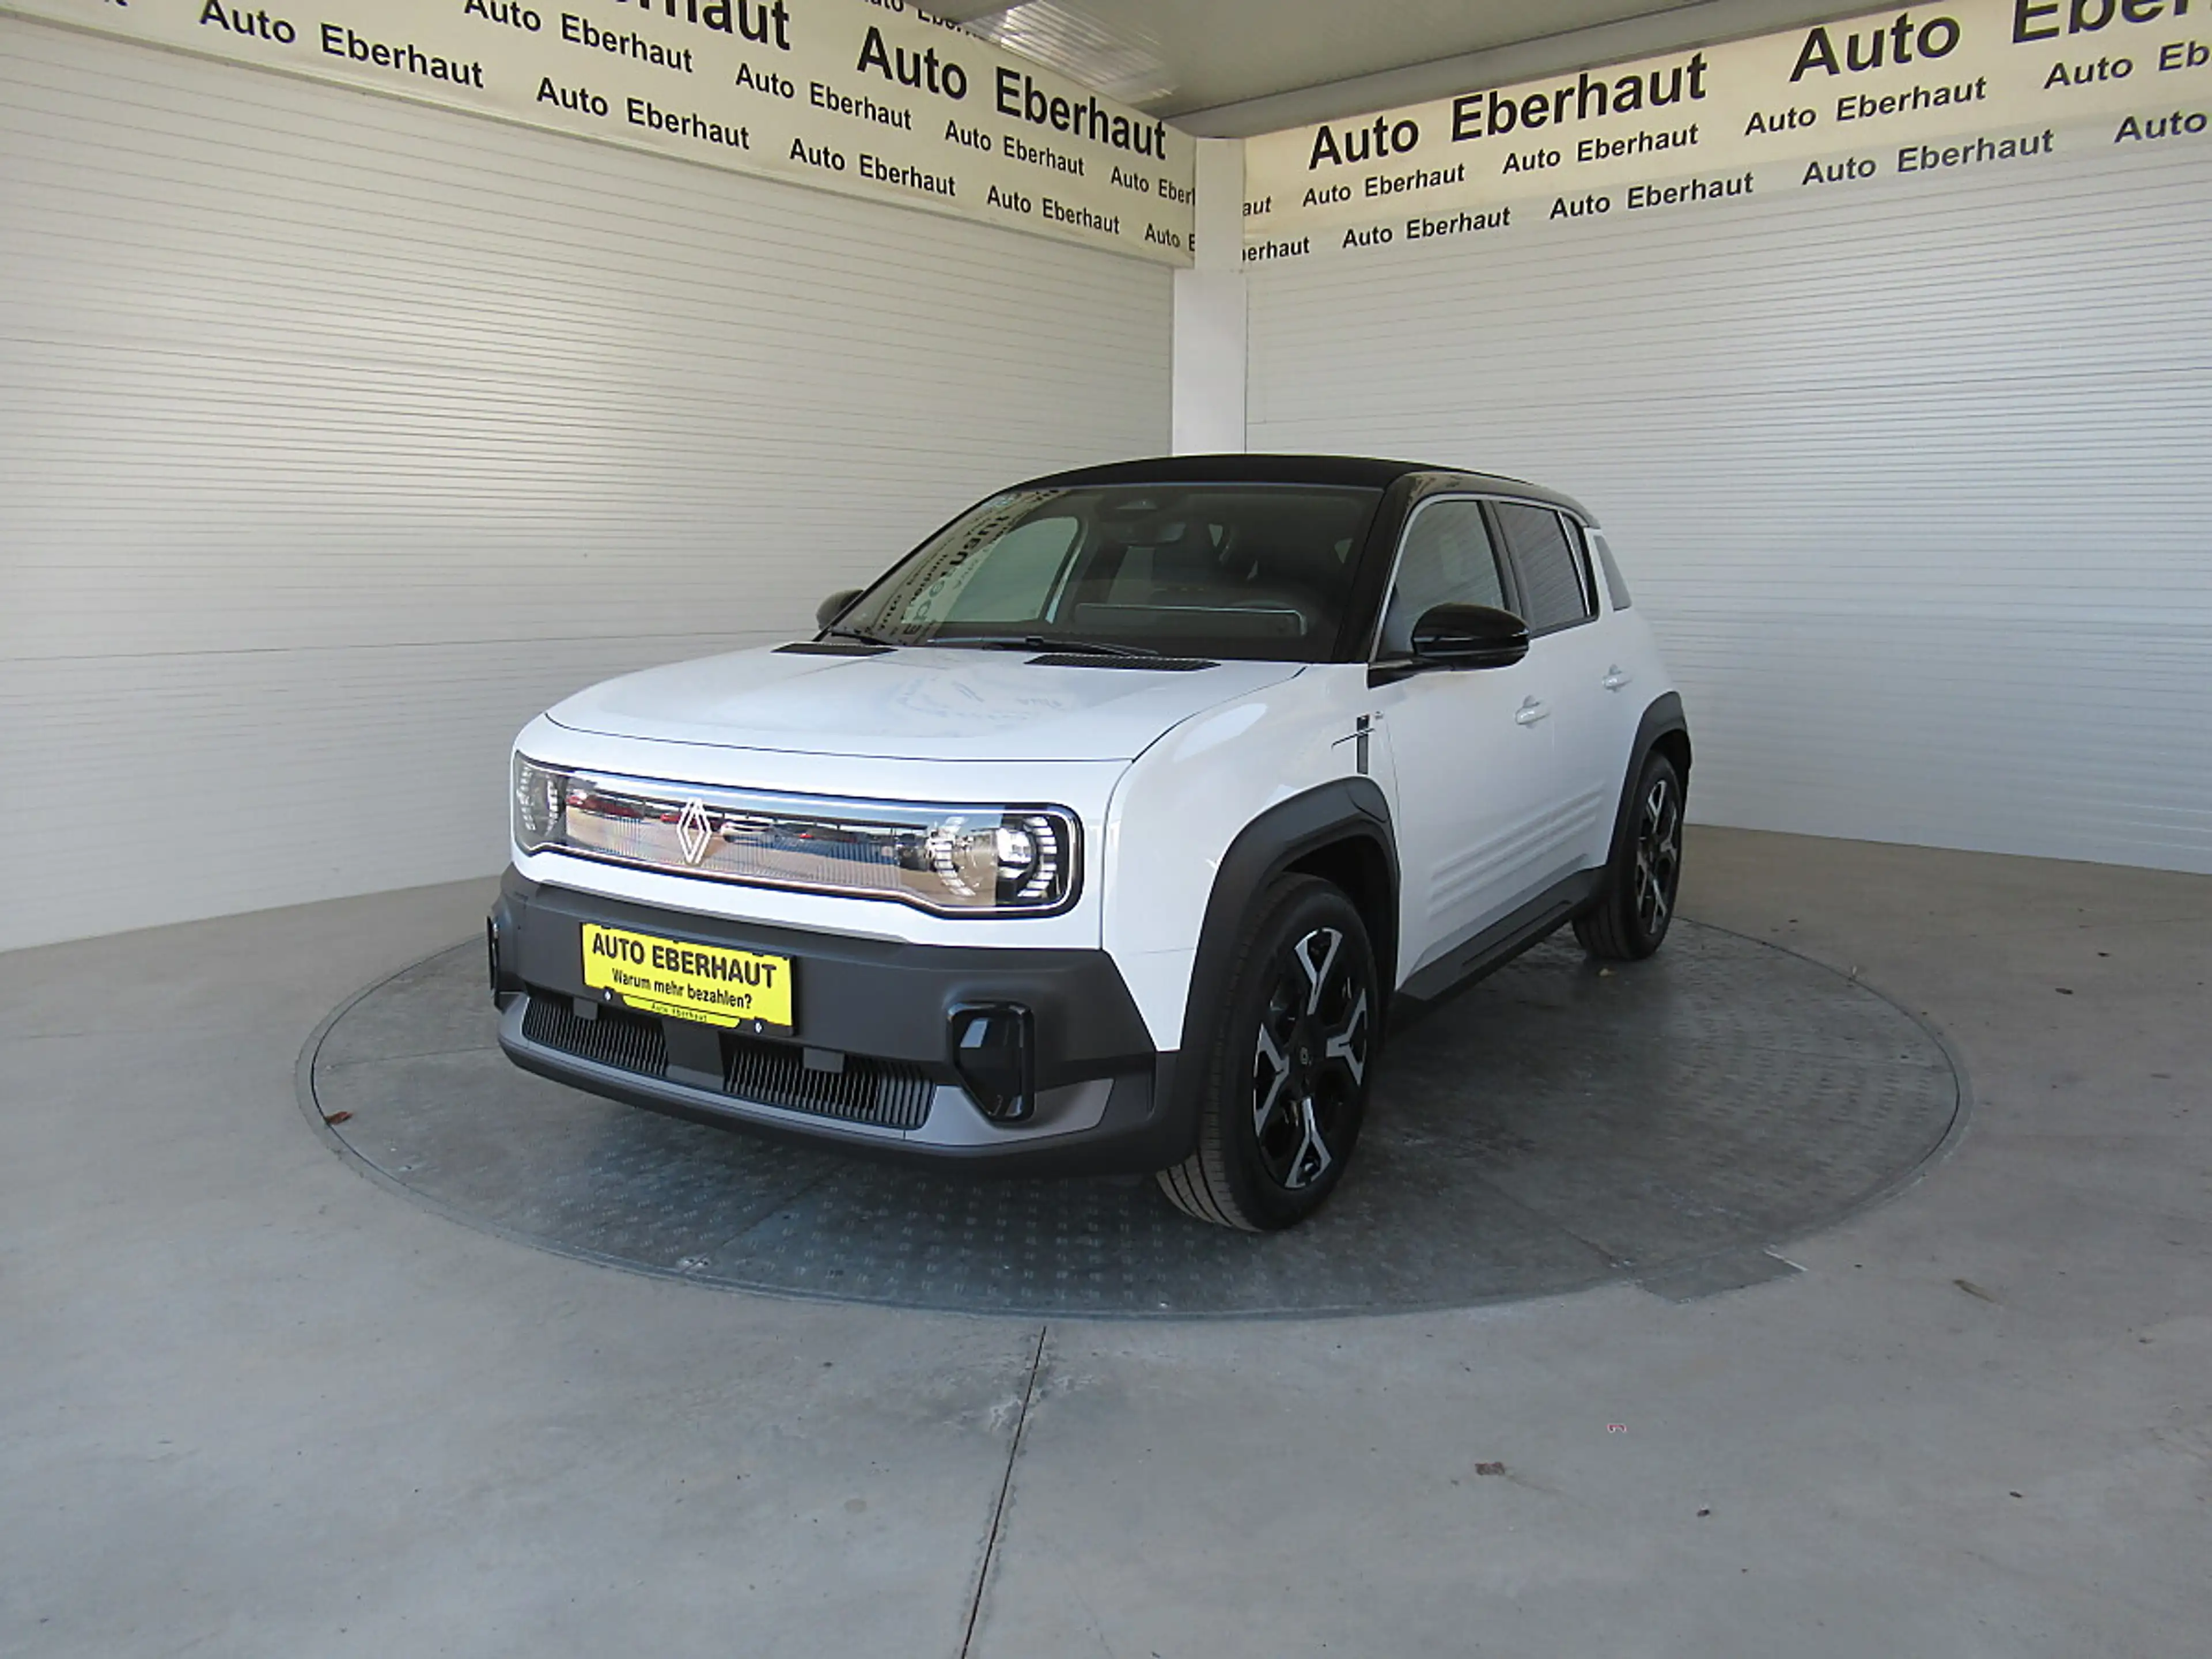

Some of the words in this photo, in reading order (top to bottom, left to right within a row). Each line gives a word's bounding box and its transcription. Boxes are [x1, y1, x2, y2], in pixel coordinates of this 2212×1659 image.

[200, 0, 296, 43] Auto
[321, 23, 484, 89] Eberhaut
[464, 0, 541, 32] Auto
[562, 13, 692, 73] Eberhaut
[1789, 13, 1960, 82] Auto
[736, 63, 794, 99] Auto
[810, 81, 911, 130] Eberhaut
[857, 26, 967, 100] Auto
[996, 66, 1167, 161] Eberhaut
[2044, 57, 2133, 89] Auto
[536, 77, 608, 116] Auto
[627, 97, 749, 150] Eberhaut
[1309, 116, 1419, 171] Auto
[1452, 52, 1707, 142] Eberhaut
[1745, 107, 1816, 135] Auto
[1836, 77, 1986, 121] Eberhaut
[2114, 111, 2207, 143] Auto
[789, 138, 845, 171] Auto
[859, 154, 956, 196] Eberhaut
[945, 119, 991, 151] Auto
[1003, 135, 1085, 176] Eberhaut
[1502, 149, 1560, 174] Auto
[1578, 124, 1698, 162] Eberhaut
[1802, 157, 1876, 185] Auto
[1898, 129, 2054, 172] Eberhaut
[1111, 165, 1149, 193] Auto
[1302, 185, 1351, 207] Auto
[1365, 163, 1464, 197] Eberhaut
[1550, 195, 1610, 220] Auto
[1628, 172, 1753, 209] Eberhaut
[987, 185, 1031, 213] Auto
[1042, 197, 1119, 234] Eberhaut
[1144, 223, 1181, 248] Auto
[1342, 226, 1393, 248] Auto
[1407, 207, 1510, 239] Eberhaut
[592, 933, 645, 964] AUTO
[652, 945, 777, 988] EBERHAUT
[612, 968, 652, 990] Warum
[654, 980, 685, 997] mehr
[687, 984, 752, 1009] bezahlen?
